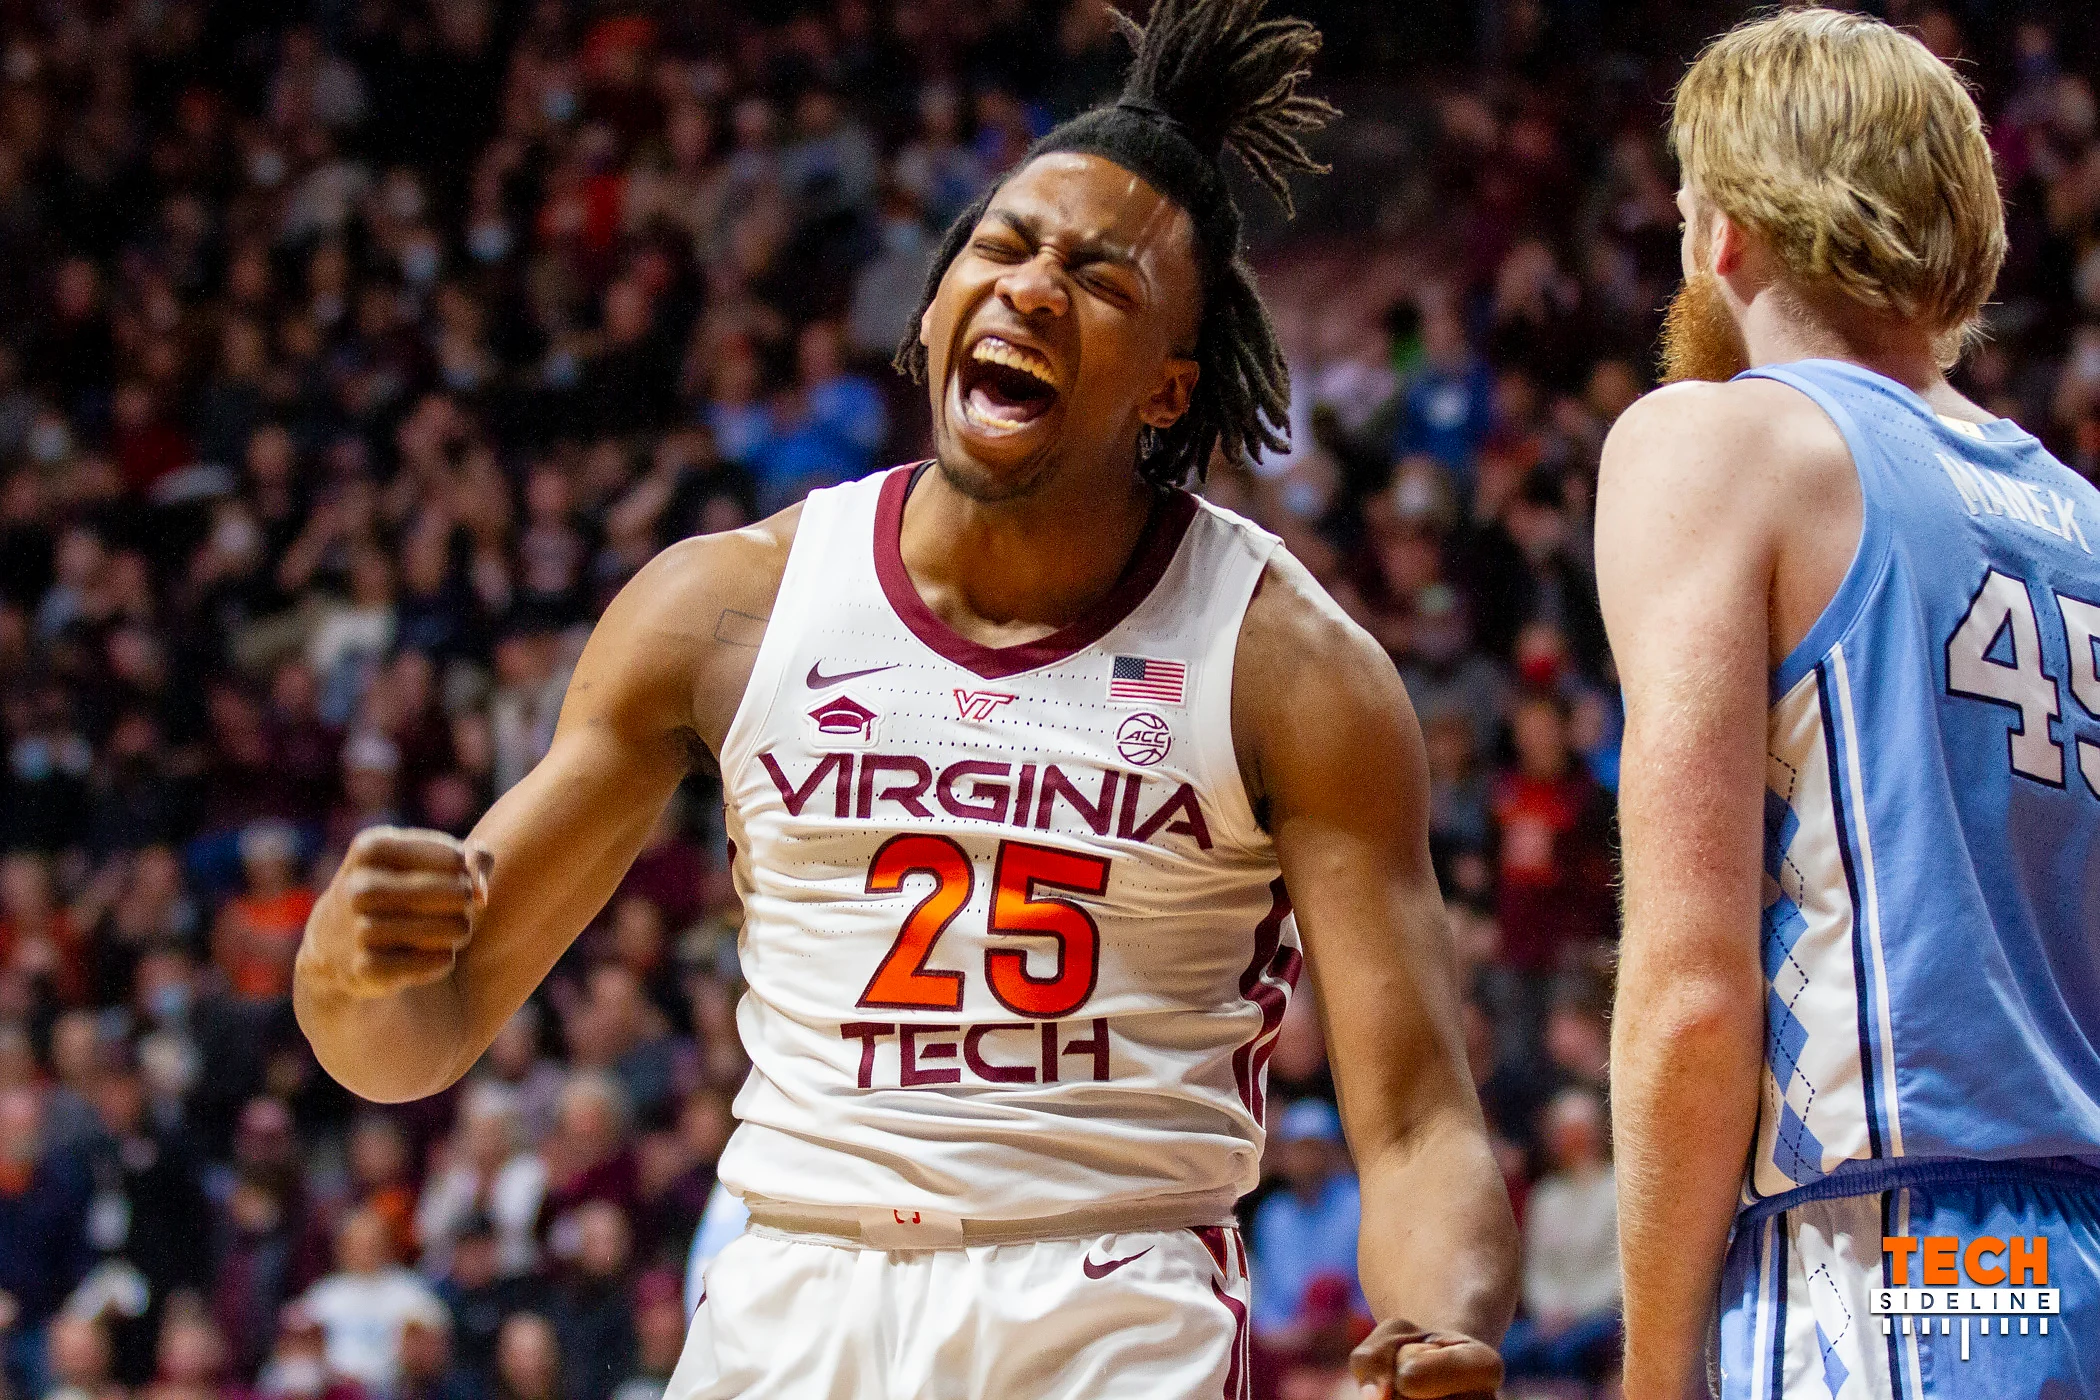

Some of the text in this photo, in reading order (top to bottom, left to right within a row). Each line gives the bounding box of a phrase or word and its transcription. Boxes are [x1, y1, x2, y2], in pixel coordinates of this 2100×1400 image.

[1936, 452, 2093, 555] MANEK
[953, 688, 1015, 721] VT
[1125, 730, 1169, 744] ACC
[758, 752, 1214, 850] VIRGINIA
[855, 832, 1112, 1020] 25
[840, 1018, 1110, 1089] TECH
